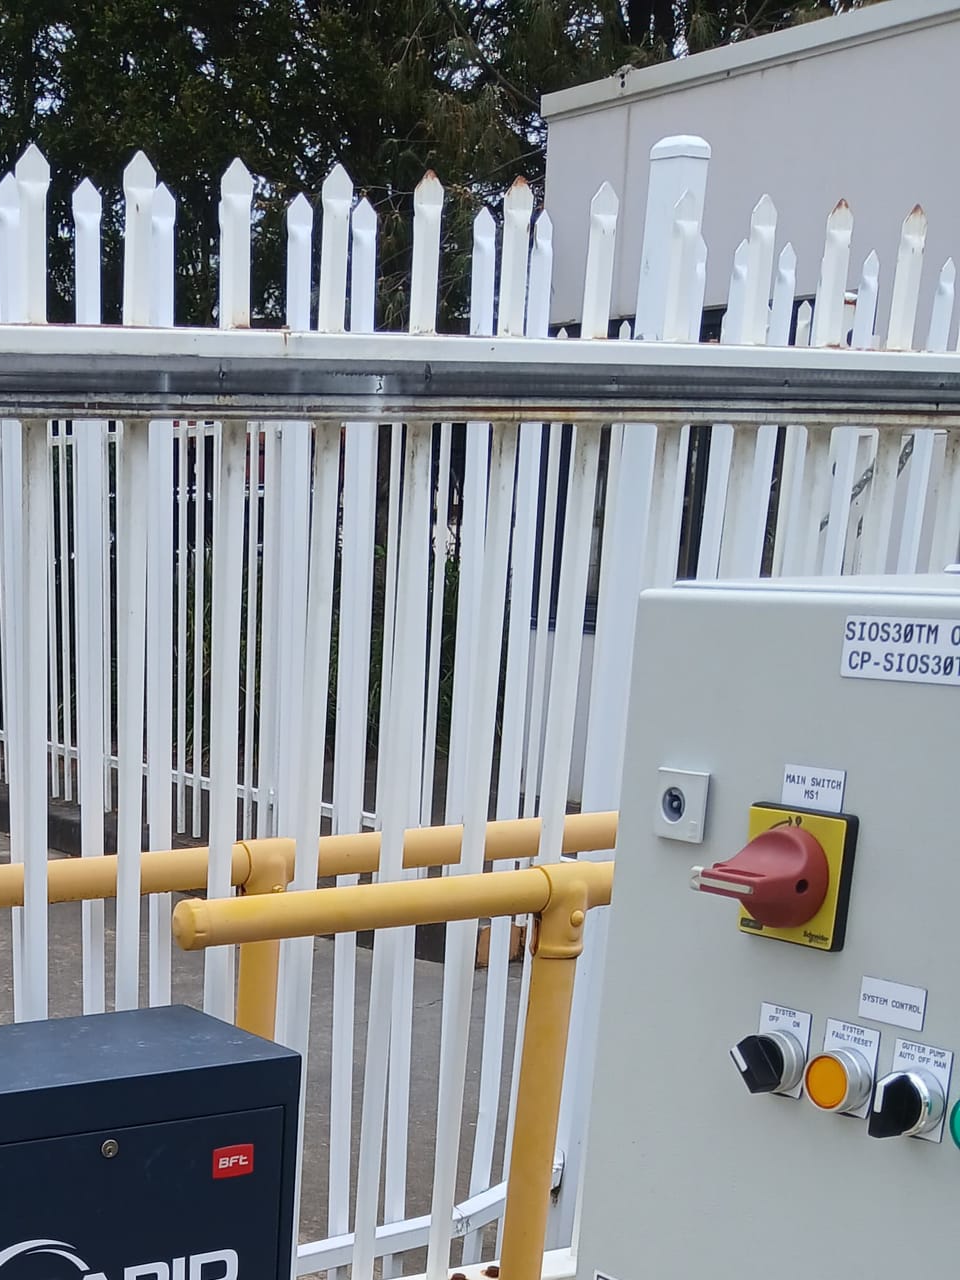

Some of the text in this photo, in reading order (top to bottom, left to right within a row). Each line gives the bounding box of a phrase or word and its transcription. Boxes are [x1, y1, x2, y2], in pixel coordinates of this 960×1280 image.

[785, 773, 842, 790] MAIN SWITCH
[804, 789, 819, 801] MS1
[862, 993, 922, 1014] SYSTEM CONTROL
[775, 1007, 796, 1018] SYSTEM
[842, 1024, 865, 1036] SYSTEM
[899, 1050, 915, 1061] AUTO
